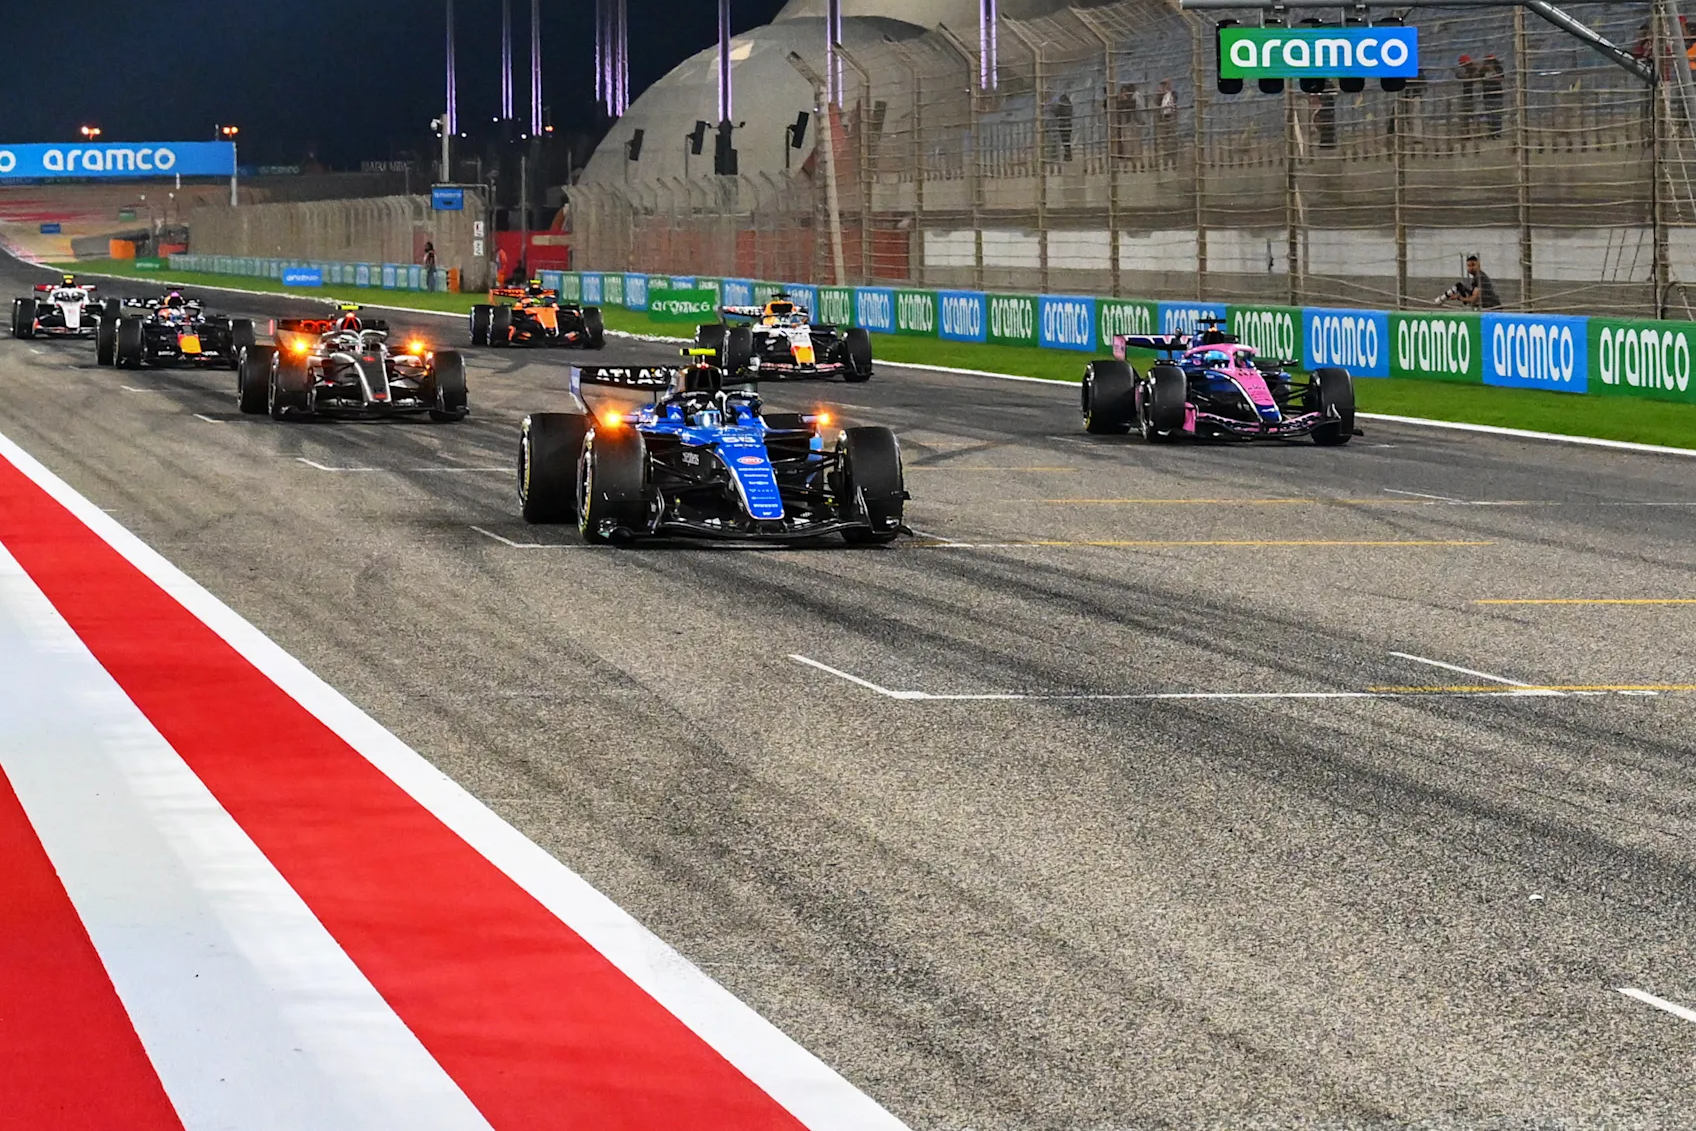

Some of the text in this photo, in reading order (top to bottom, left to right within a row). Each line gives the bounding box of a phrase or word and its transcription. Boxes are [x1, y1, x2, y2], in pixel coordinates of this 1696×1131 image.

[1230, 37, 1408, 68] aramco
[43, 148, 176, 172] aramco
[858, 292, 890, 329] aramco
[899, 294, 933, 333] aramco
[942, 297, 980, 337] aramco
[991, 298, 1033, 339] aramco
[1044, 301, 1089, 345] aramco
[1311, 316, 1379, 369] aramco
[1398, 319, 1470, 375] aramco
[1493, 323, 1574, 382] aramco
[1600, 327, 1690, 392] aramco
